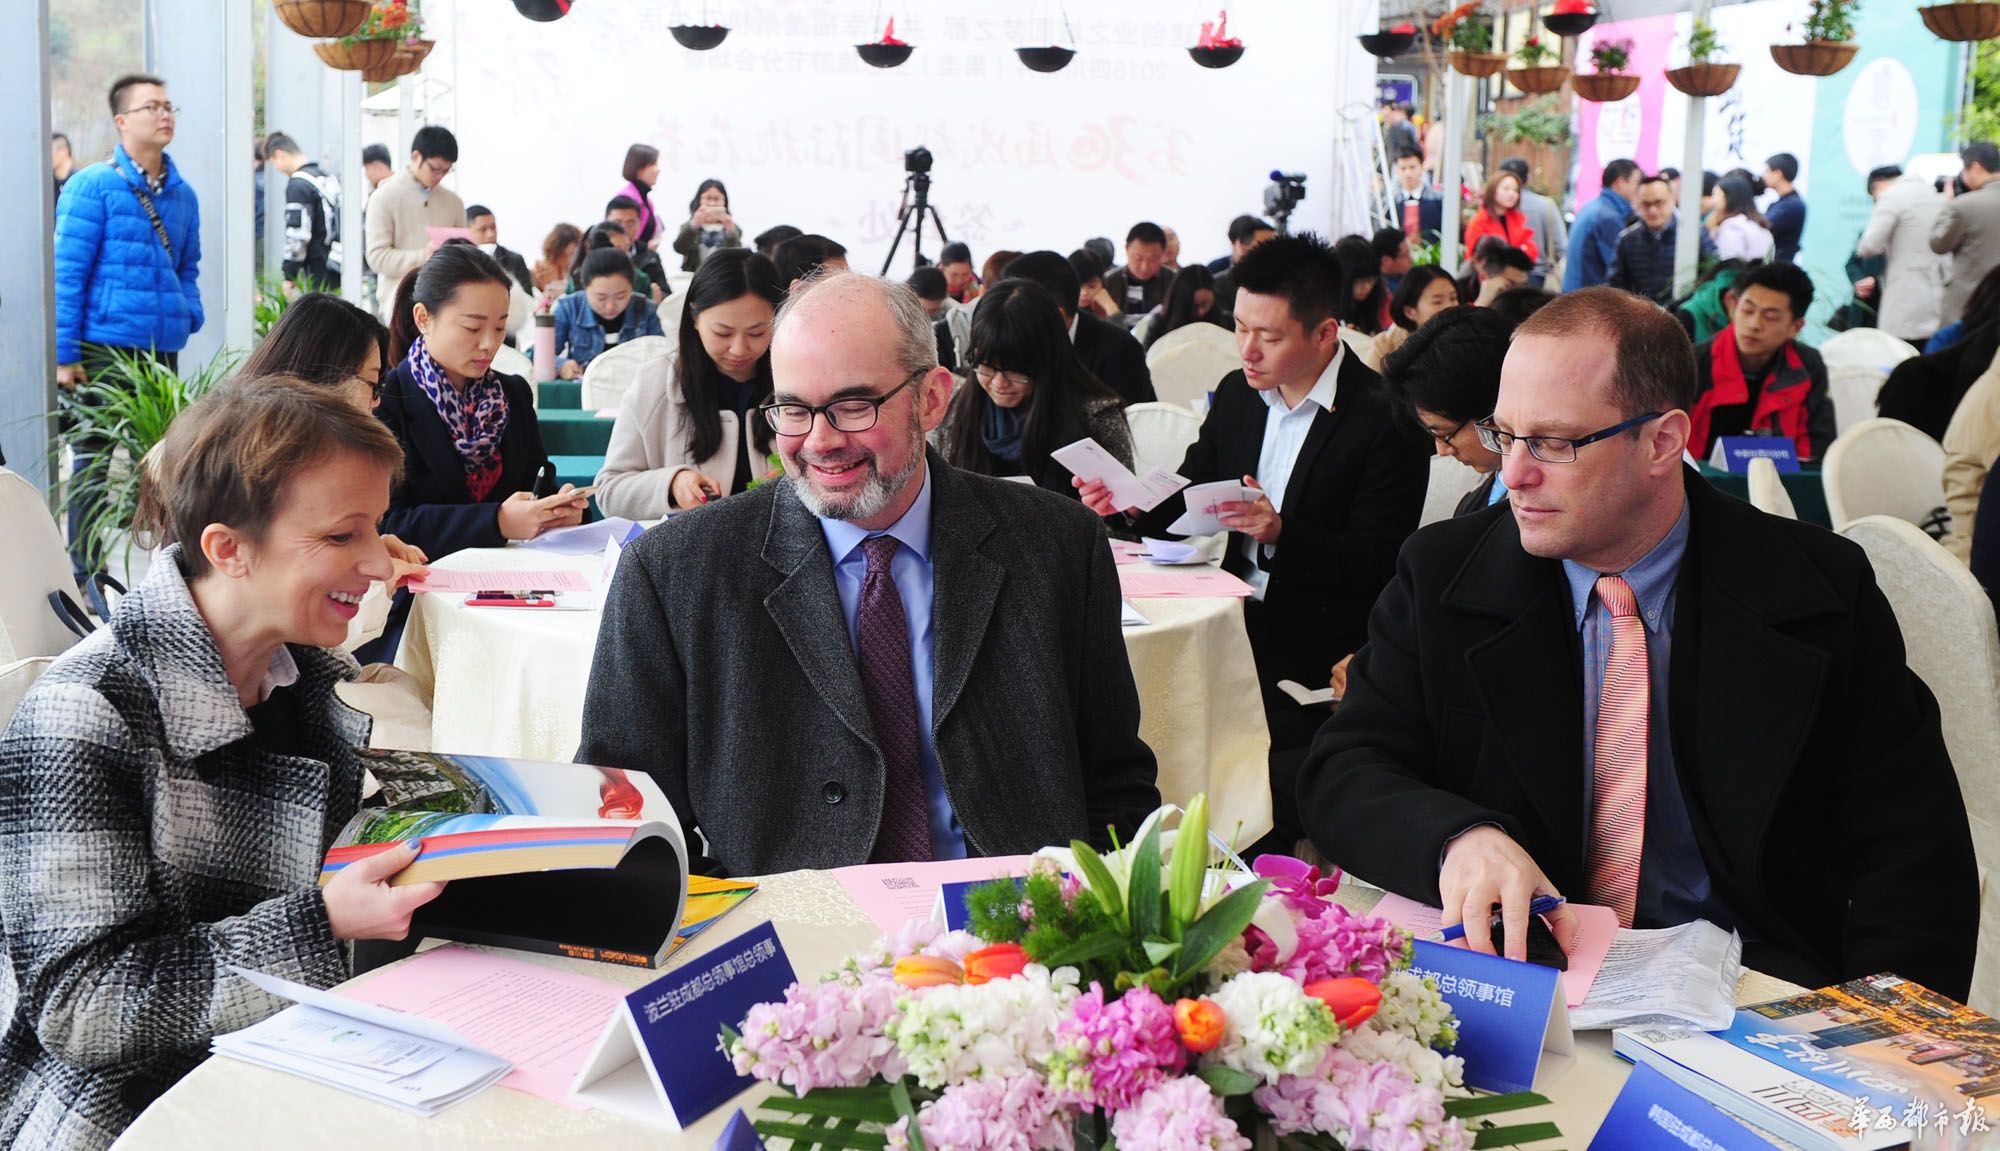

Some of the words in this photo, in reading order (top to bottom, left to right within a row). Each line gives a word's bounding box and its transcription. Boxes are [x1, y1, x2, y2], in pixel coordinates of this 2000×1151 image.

[644, 938, 776, 1024] 波兰驻成都总领事馆总领事
